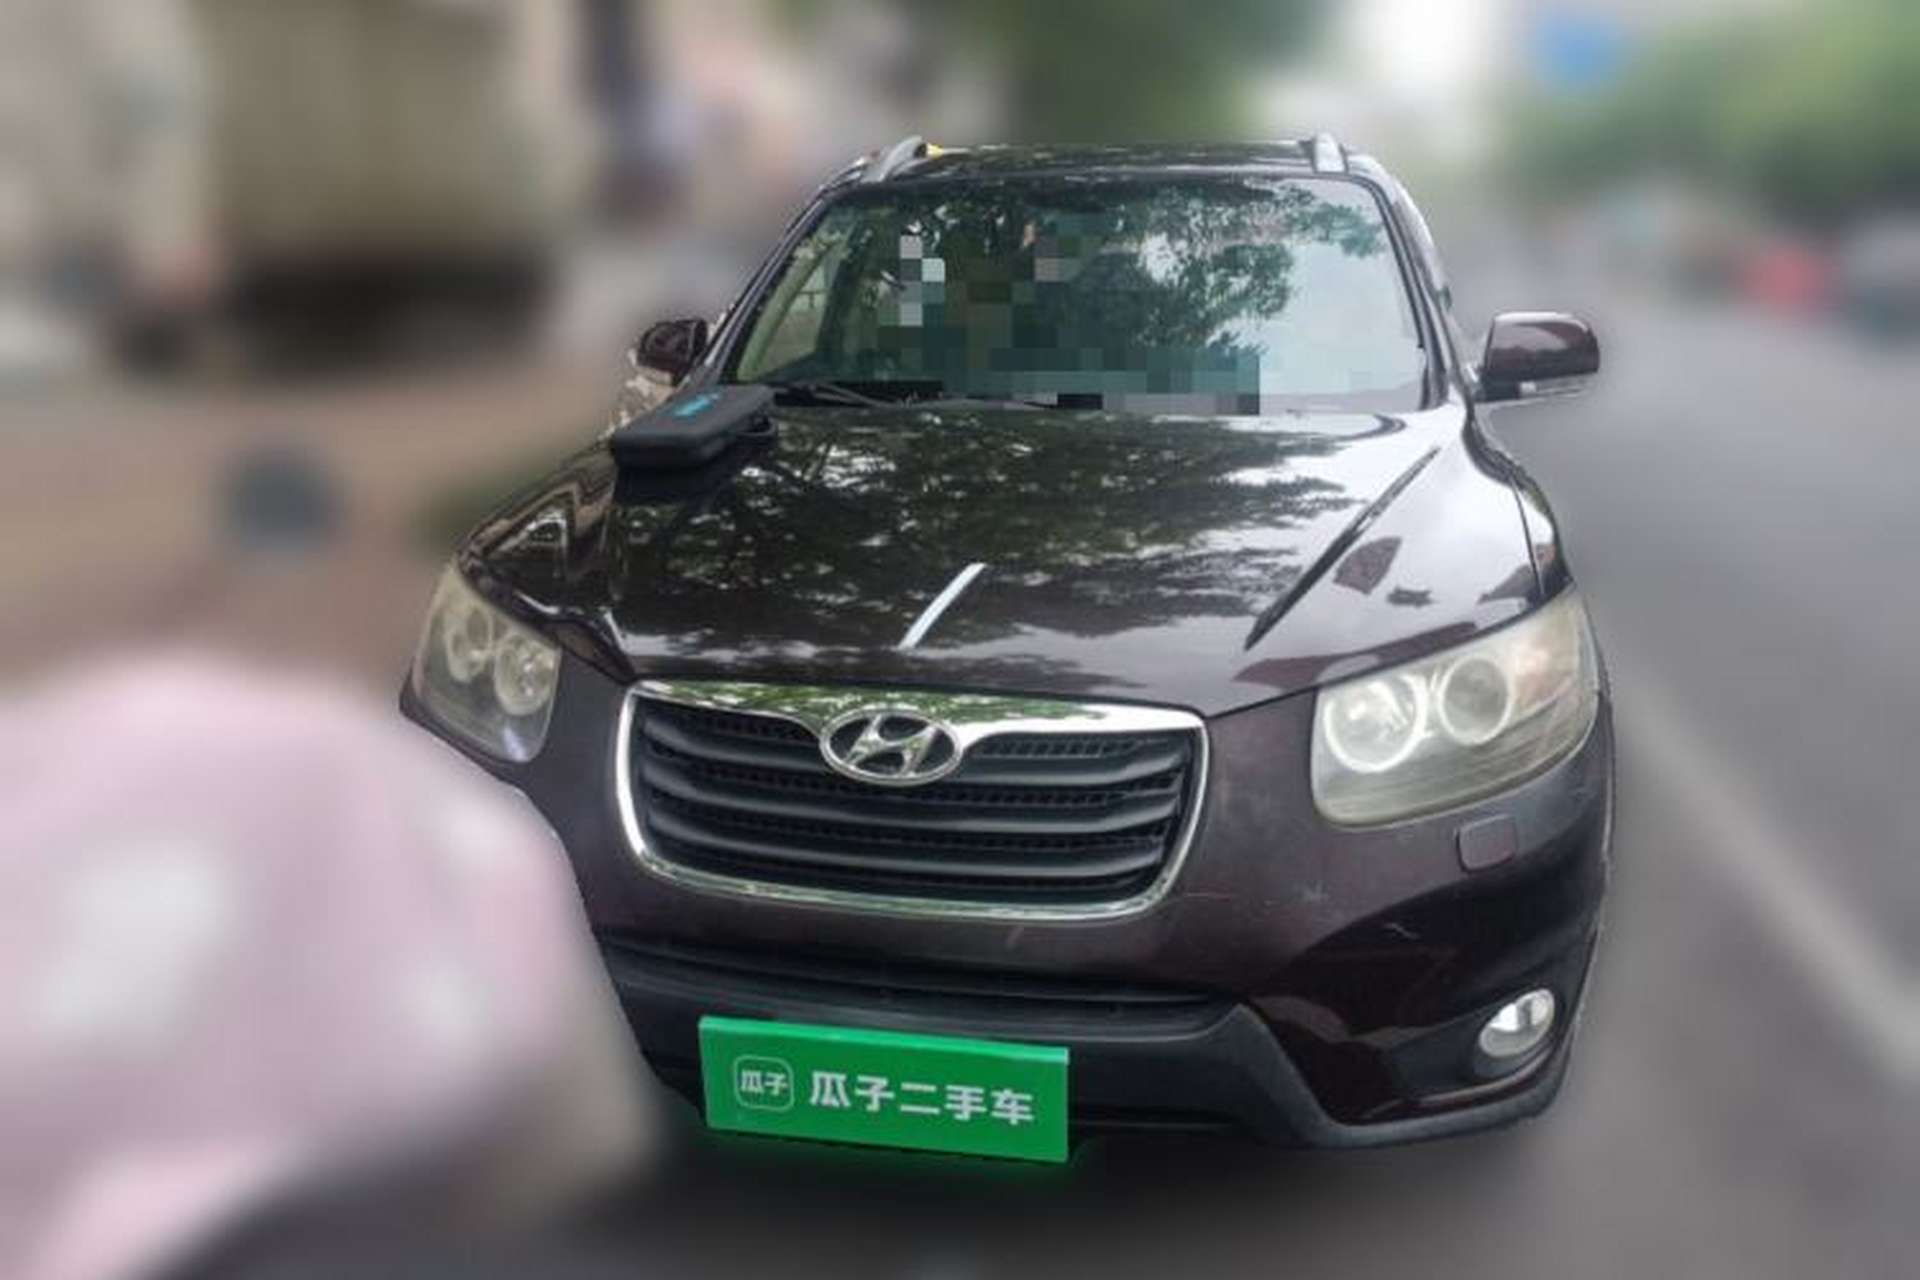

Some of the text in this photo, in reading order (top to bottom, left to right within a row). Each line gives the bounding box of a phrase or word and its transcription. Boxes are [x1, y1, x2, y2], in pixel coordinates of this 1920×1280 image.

[740, 1070, 1035, 1125] 瓜子 瓜子二手车
